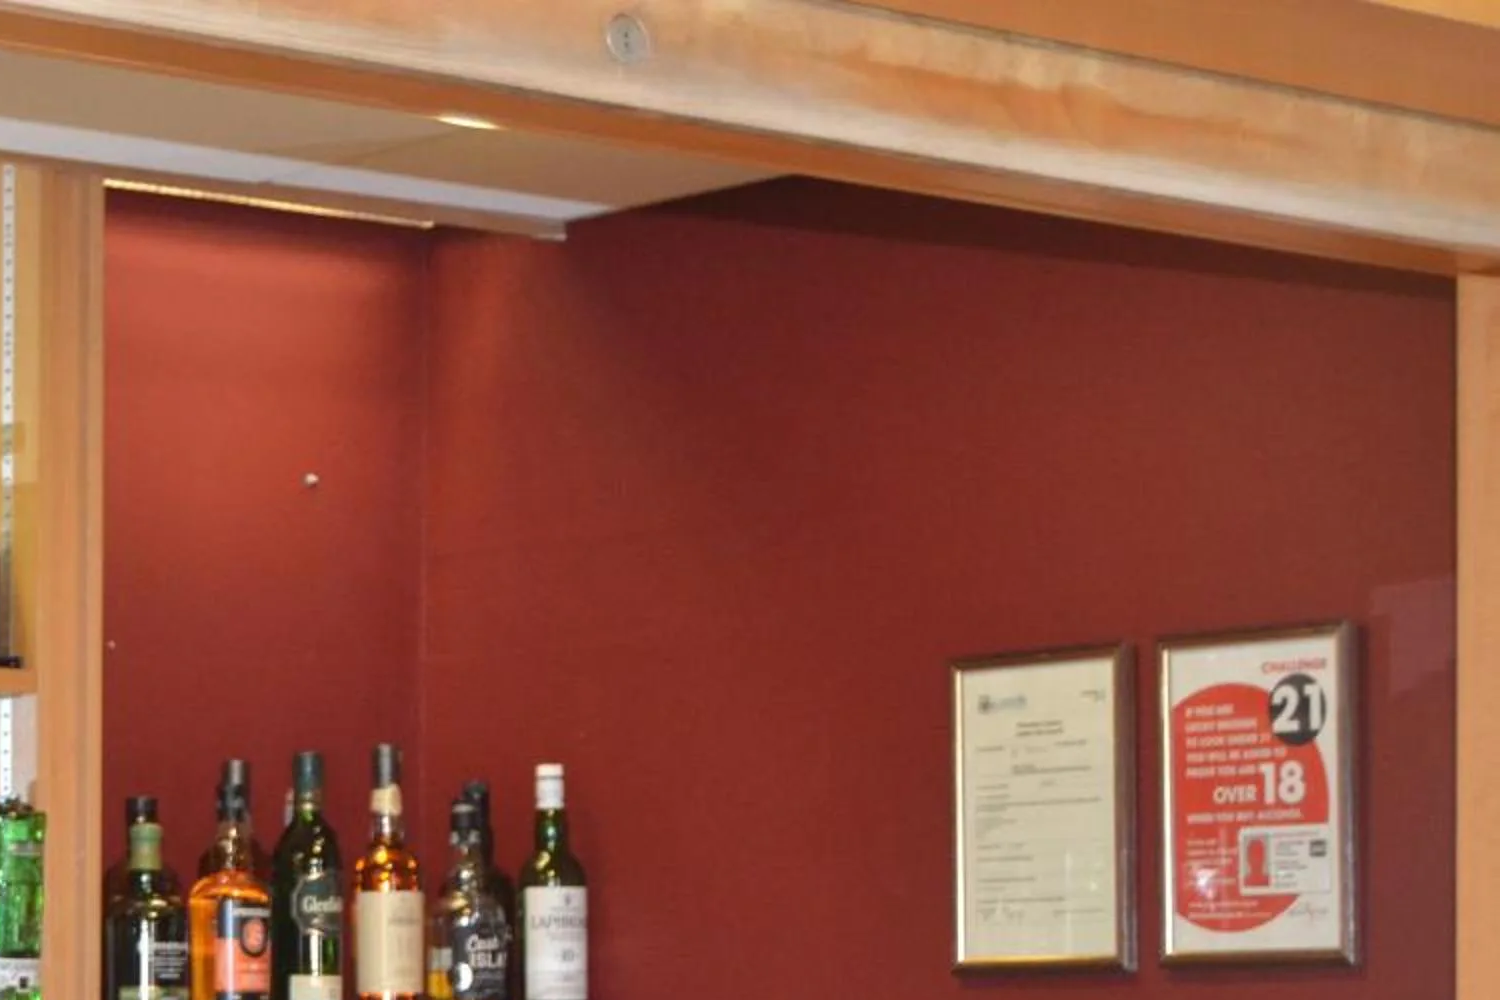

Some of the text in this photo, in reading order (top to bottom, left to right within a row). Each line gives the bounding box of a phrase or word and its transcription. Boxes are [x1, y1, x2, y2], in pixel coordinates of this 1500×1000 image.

[1273, 684, 1322, 731] 21
[1213, 760, 1306, 805] OVER 18
